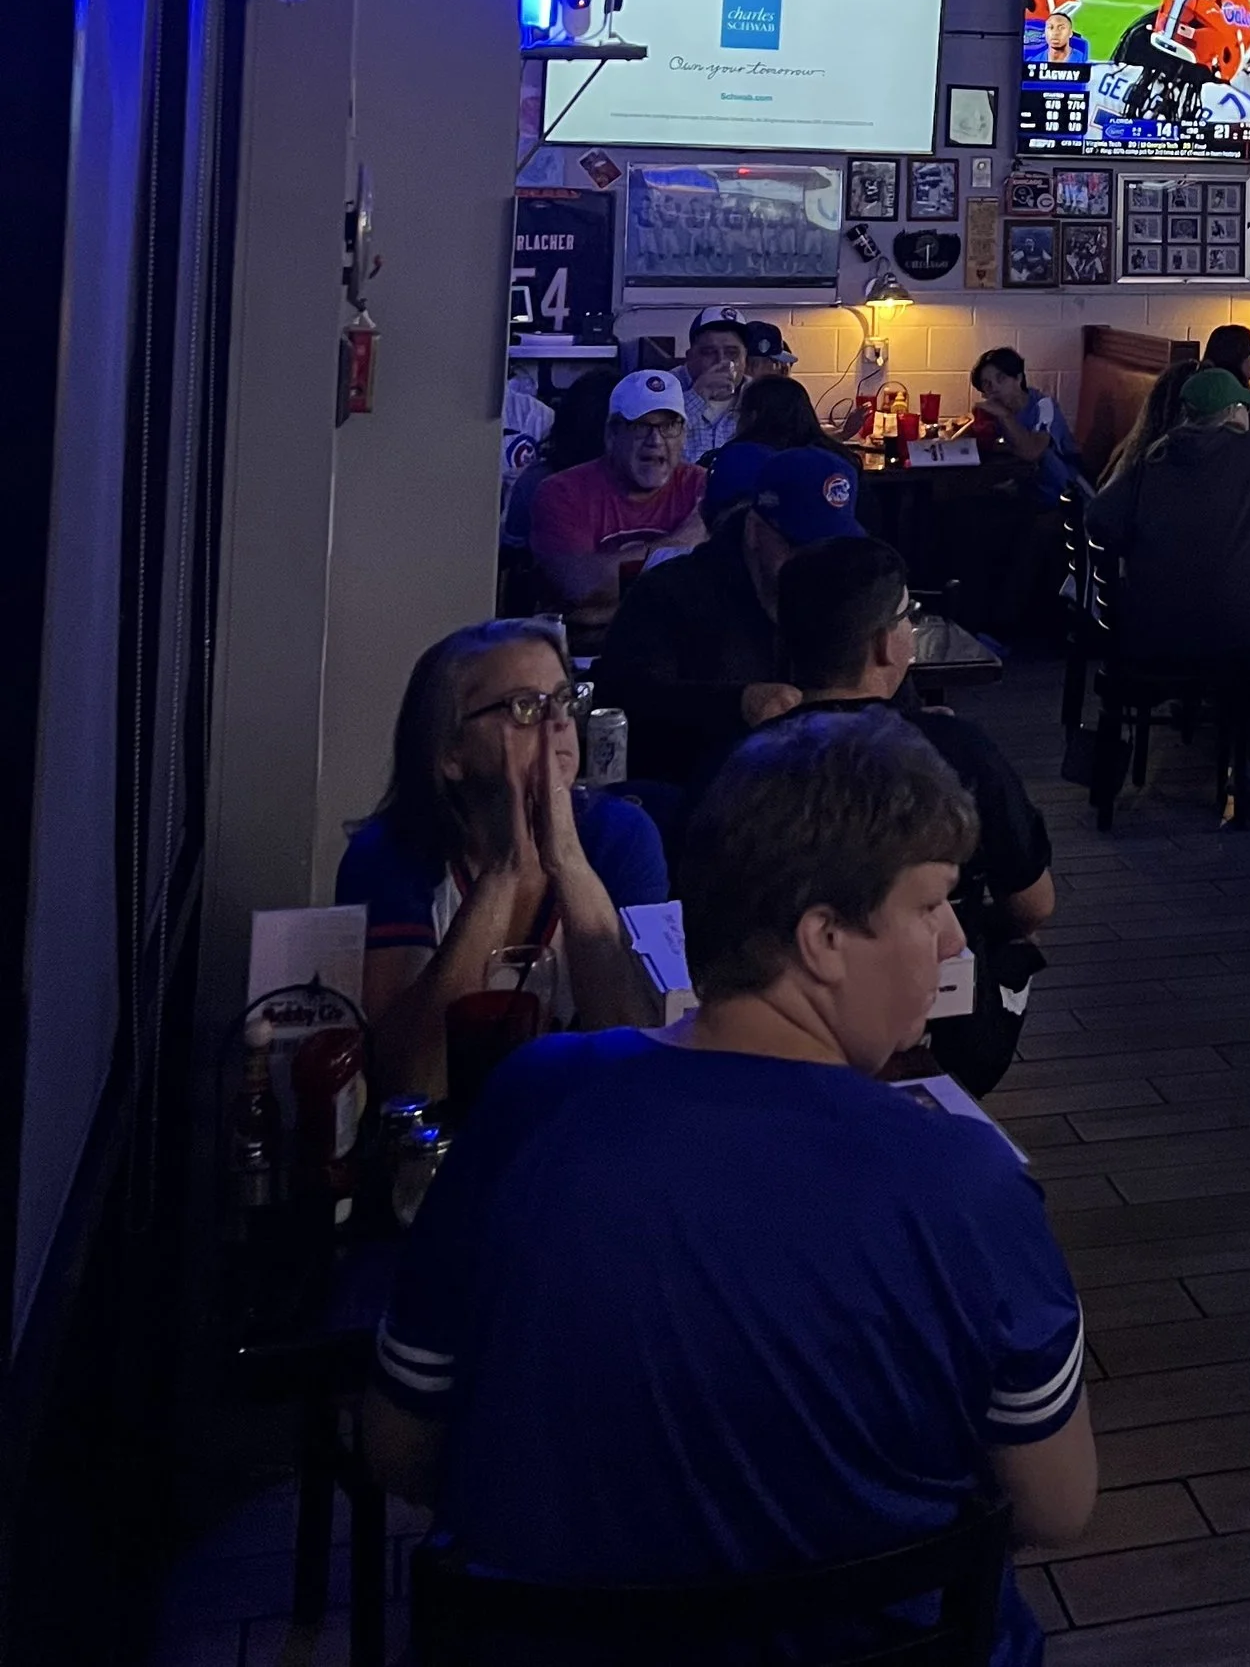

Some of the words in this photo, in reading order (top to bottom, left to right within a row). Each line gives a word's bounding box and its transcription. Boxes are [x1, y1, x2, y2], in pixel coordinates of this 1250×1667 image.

[727, 5, 775, 22] charles
[727, 21, 776, 33] SCHWAB
[669, 56, 703, 71] Own
[706, 63, 746, 80] your
[1039, 70, 1080, 81] LAGWAY
[1156, 122, 1172, 138] 14
[1214, 124, 1230, 139] 21
[516, 234, 574, 251] RLACHER
